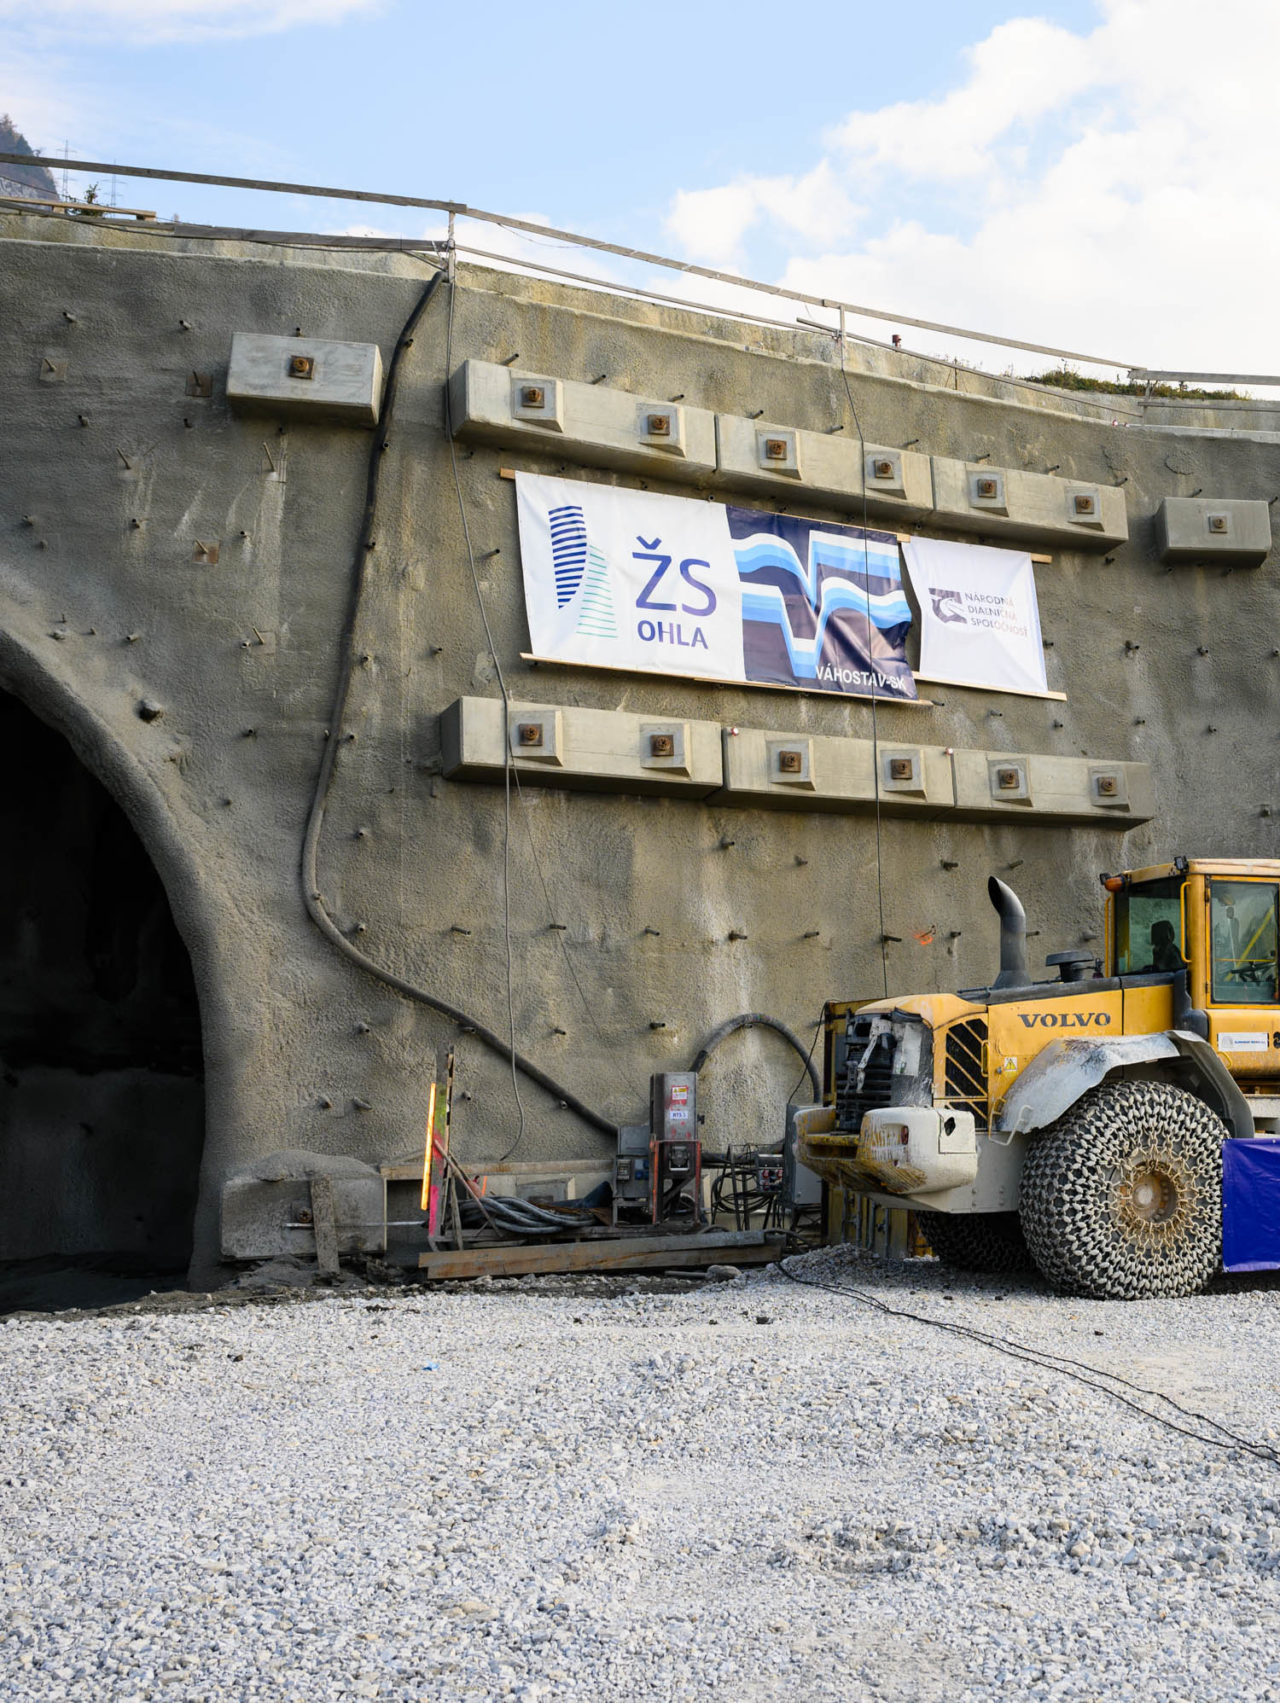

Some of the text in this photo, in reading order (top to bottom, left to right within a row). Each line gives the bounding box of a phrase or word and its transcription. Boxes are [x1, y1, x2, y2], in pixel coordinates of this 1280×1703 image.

[631, 535, 717, 617] ŽS
[637, 619, 709, 650] OHLA
[815, 662, 907, 691] VÁHOSTAV-SK
[1017, 1012, 1111, 1028] VOLVO
